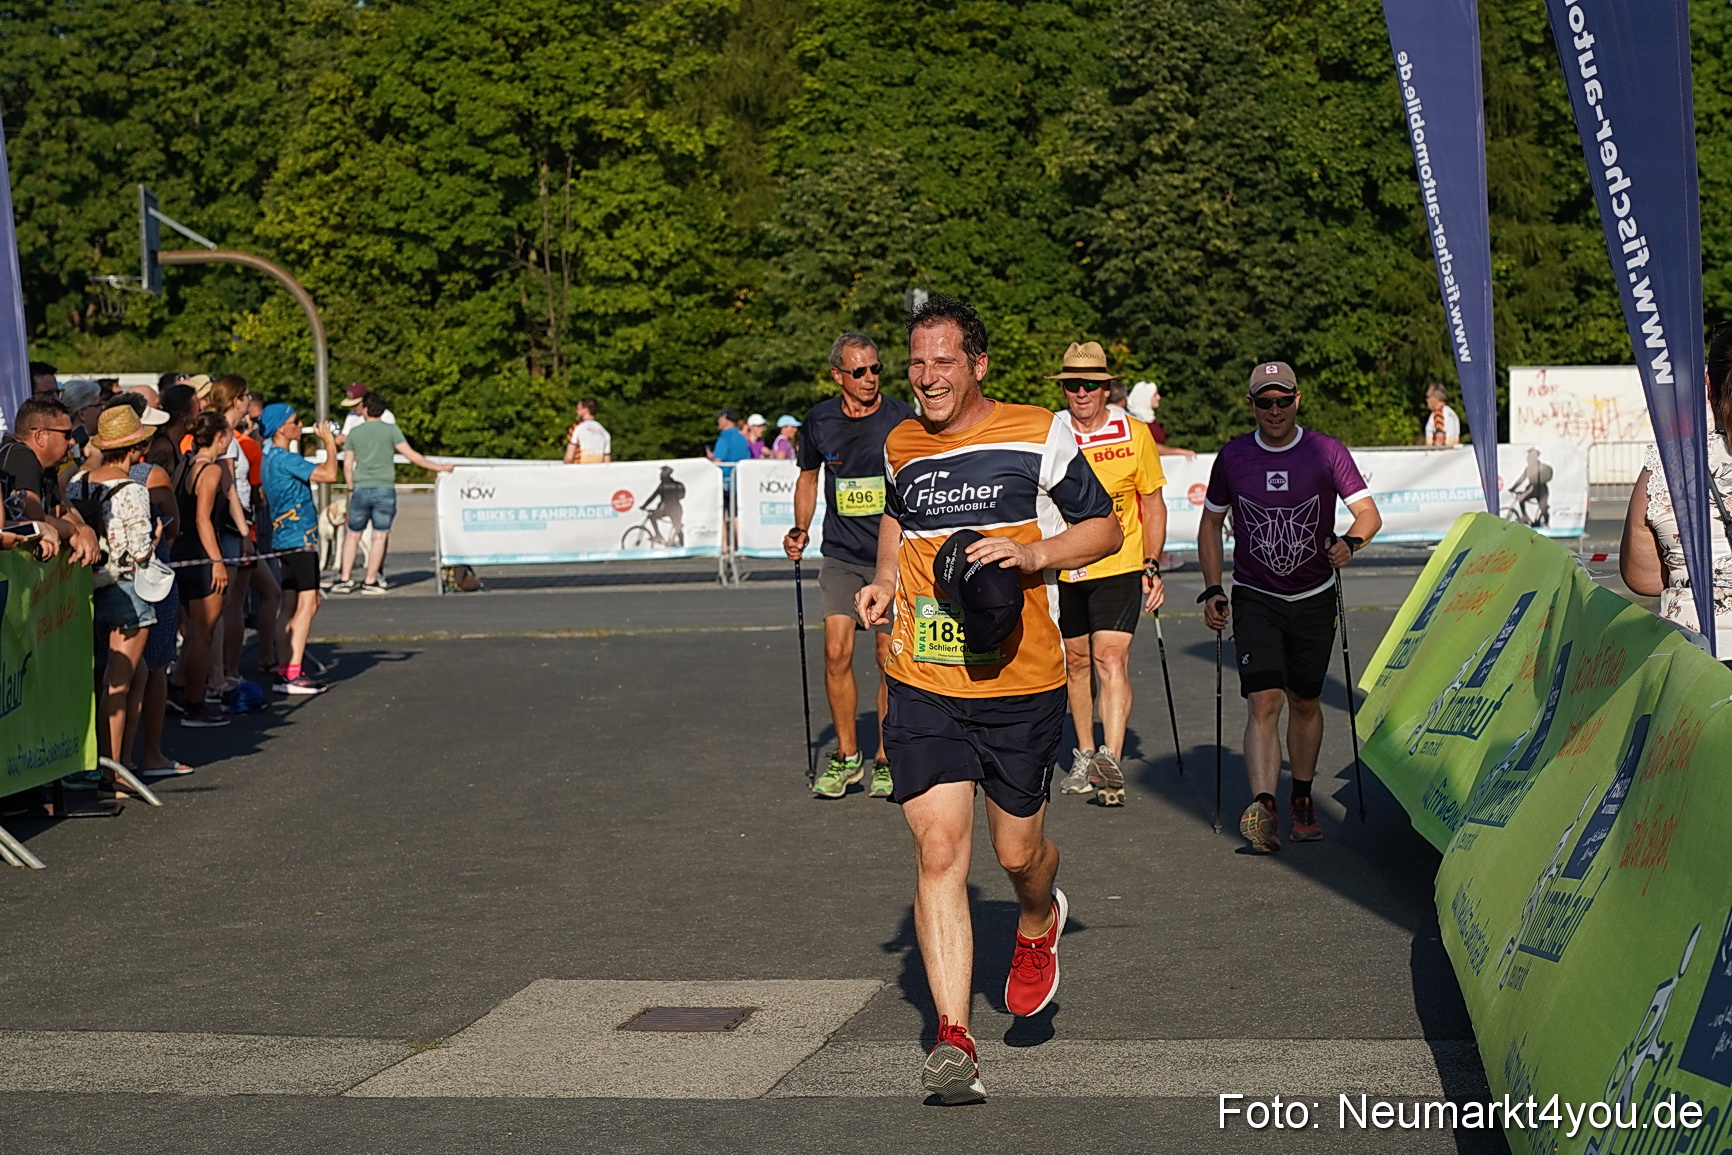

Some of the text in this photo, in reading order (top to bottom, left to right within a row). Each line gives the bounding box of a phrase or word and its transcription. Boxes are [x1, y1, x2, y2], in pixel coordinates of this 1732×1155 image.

[1093, 448, 1135, 463] BÖGL
[460, 487, 496, 500] NOW
[847, 490, 874, 504] 496
[916, 482, 1003, 507] Fischer
[463, 510, 515, 522] E-BIKES
[518, 509, 528, 520] &
[925, 501, 997, 516] AUTOMOBILE
[918, 621, 927, 653] WALK
[928, 643, 958, 653] Schlierf
